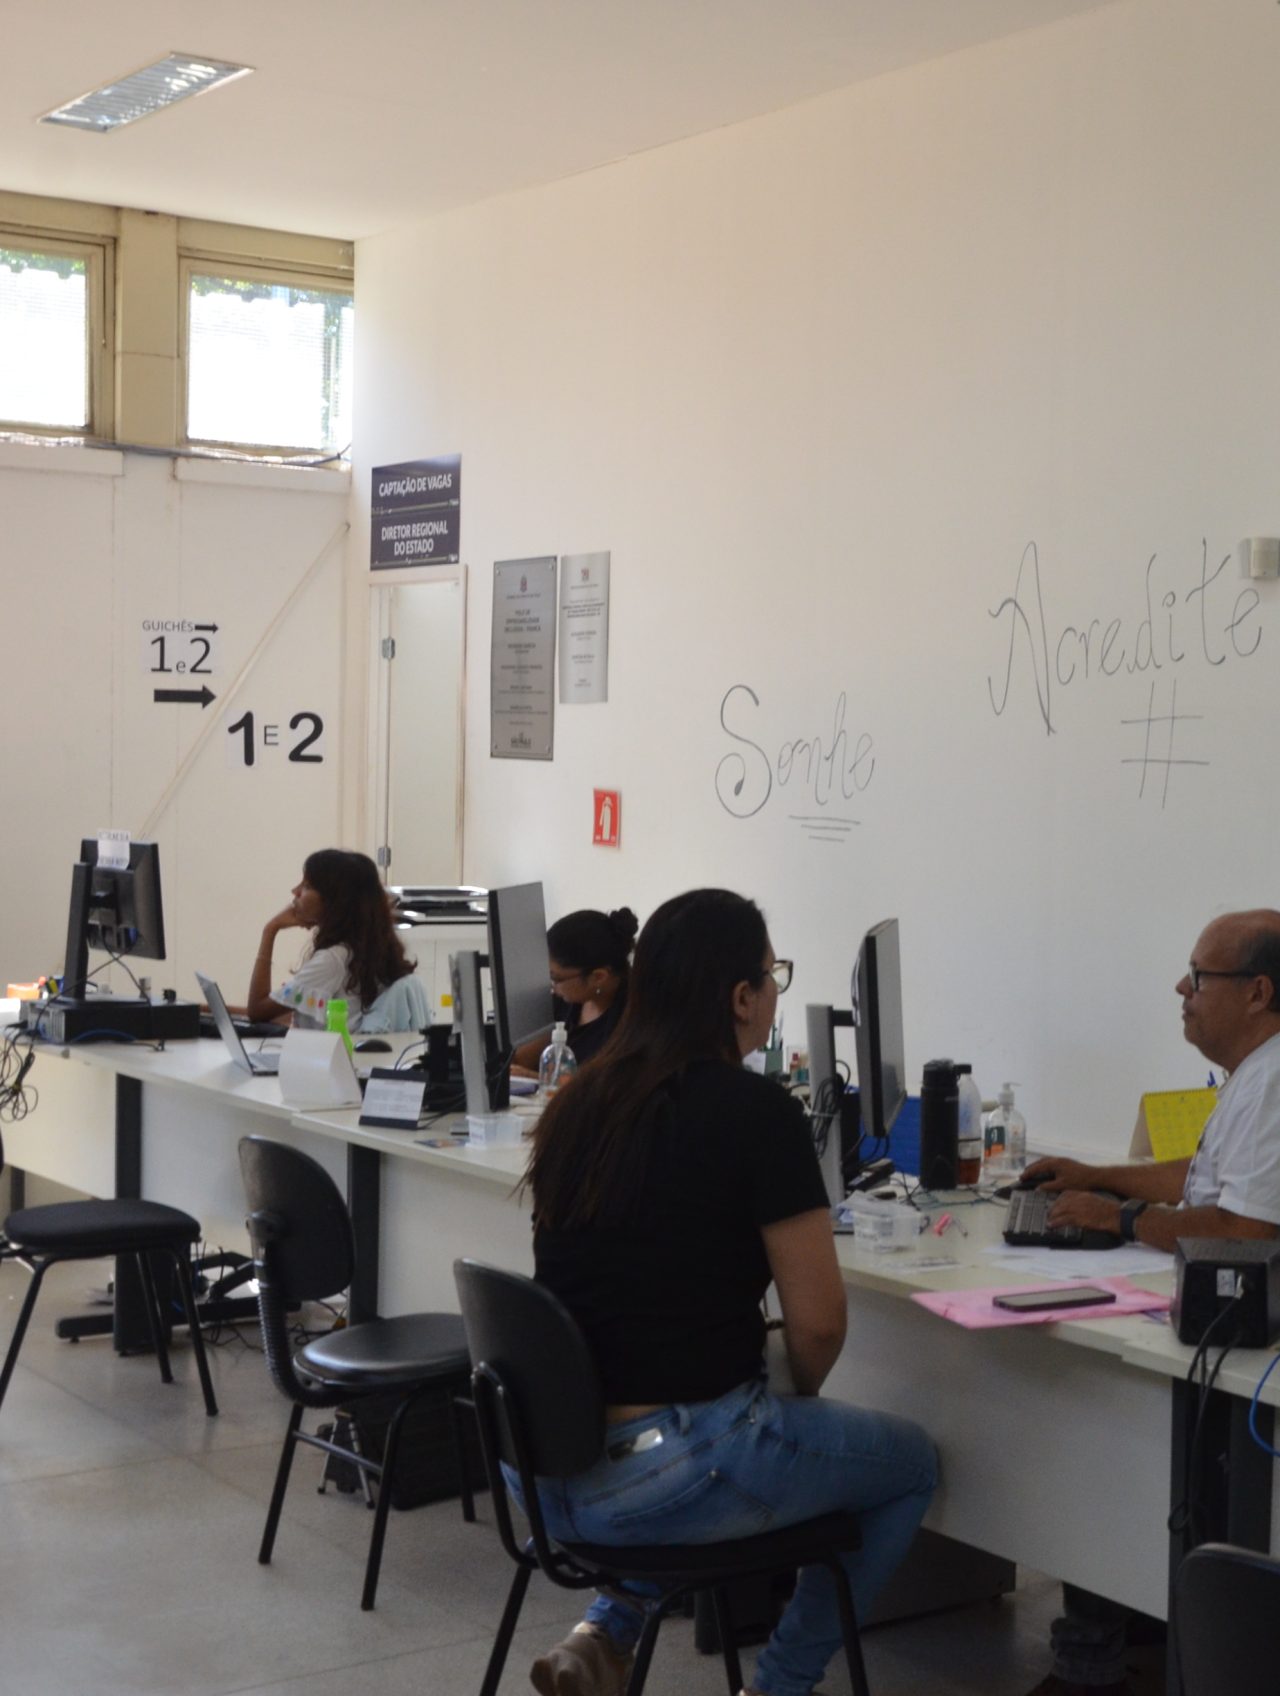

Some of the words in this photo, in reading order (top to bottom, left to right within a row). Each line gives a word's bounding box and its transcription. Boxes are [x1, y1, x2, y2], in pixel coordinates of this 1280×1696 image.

[379, 476, 416, 497] CAPTAÇÃO
[417, 478, 427, 492] DE
[428, 473, 452, 490] VAGAS
[381, 525, 411, 541] DIRETOR
[412, 520, 448, 537] REGIONAL
[394, 540, 405, 556] DO
[406, 538, 434, 555] ESTADO
[151, 635, 173, 673] 1
[190, 637, 212, 674] 2
[988, 537, 1263, 737] Acredite
[228, 711, 255, 767] 1
[264, 725, 279, 746] E
[288, 711, 324, 763] 2
[715, 684, 875, 819] Sonhe
